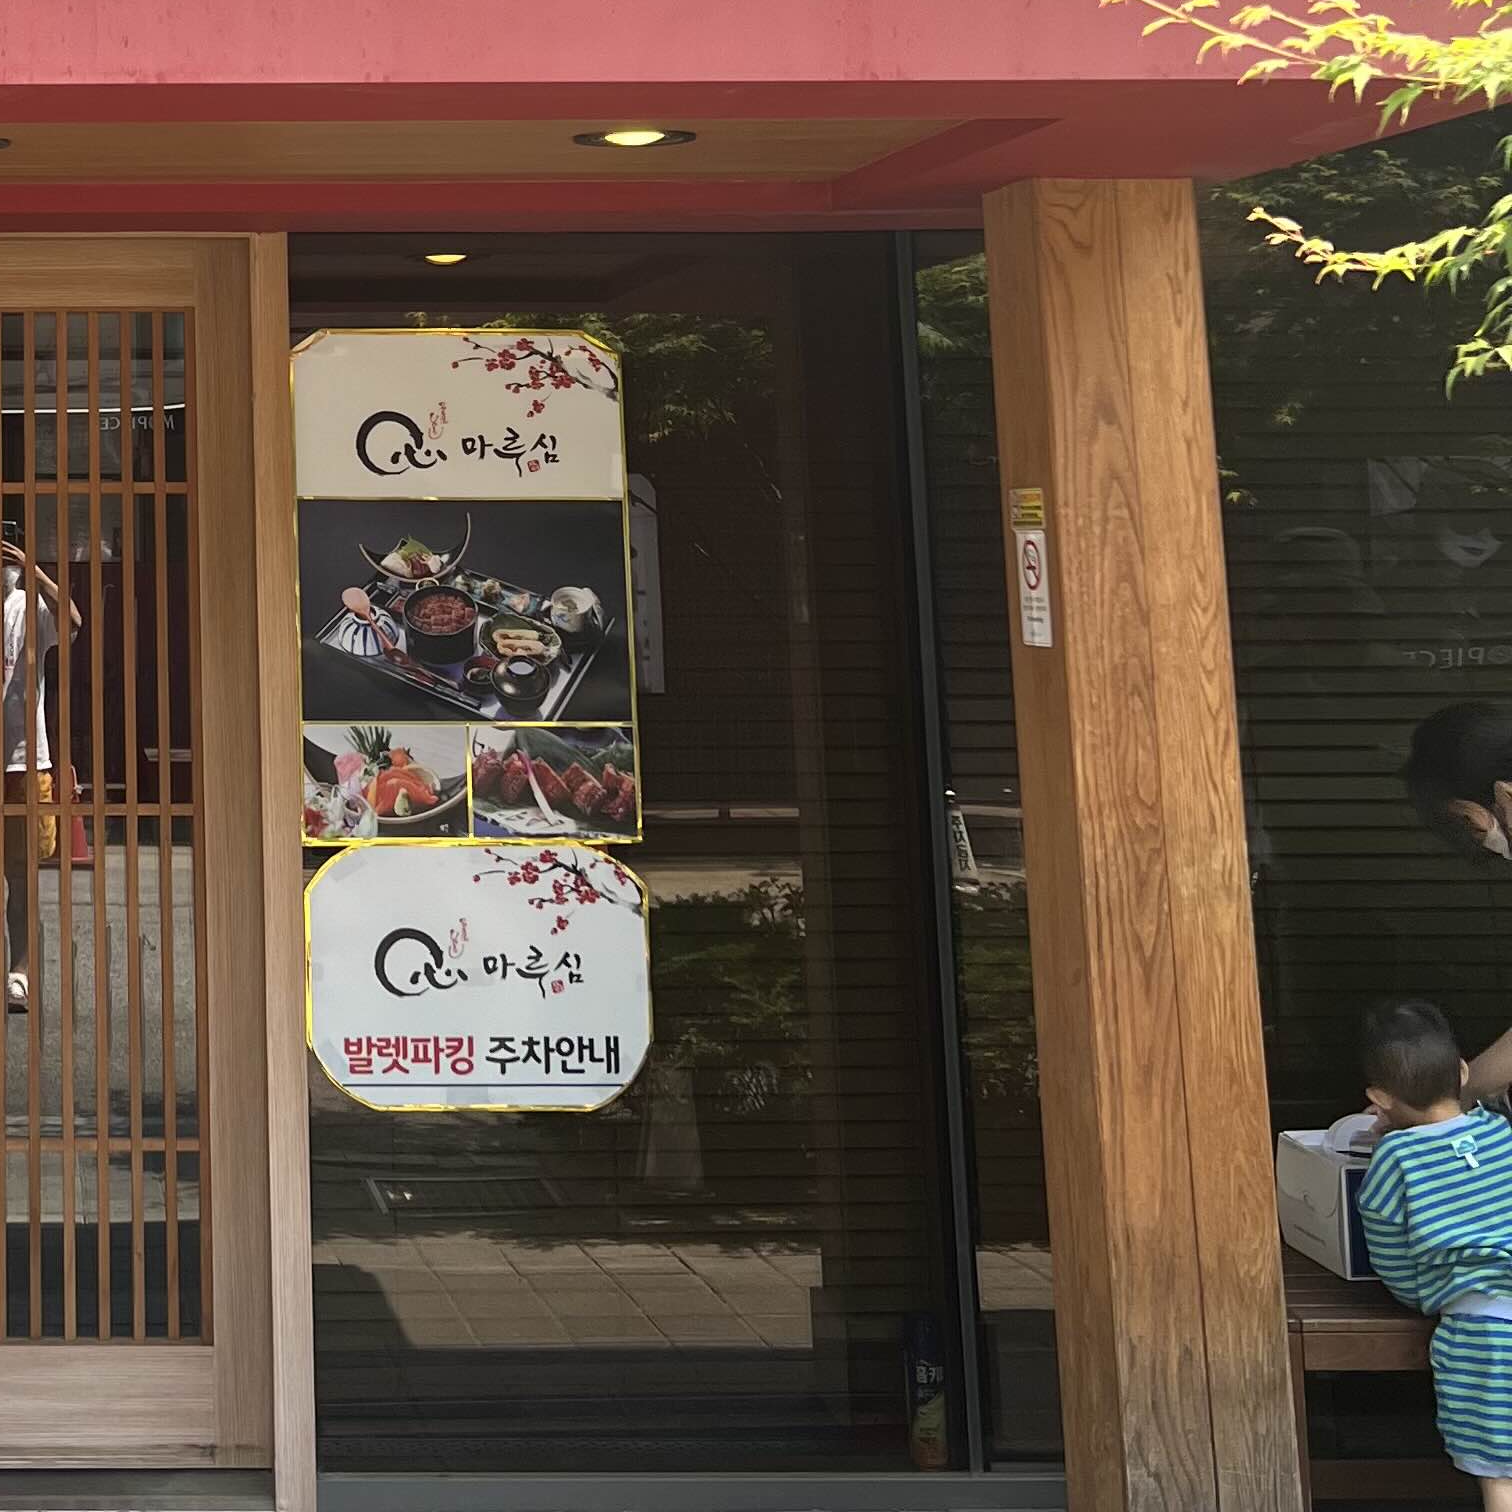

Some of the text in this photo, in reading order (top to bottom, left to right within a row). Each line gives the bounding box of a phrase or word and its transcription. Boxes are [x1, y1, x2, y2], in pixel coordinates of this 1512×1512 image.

[461, 427, 560, 478] 마루심
[482, 945, 584, 999] 마루심
[343, 1035, 620, 1076] 발렛파킹 주차안내
